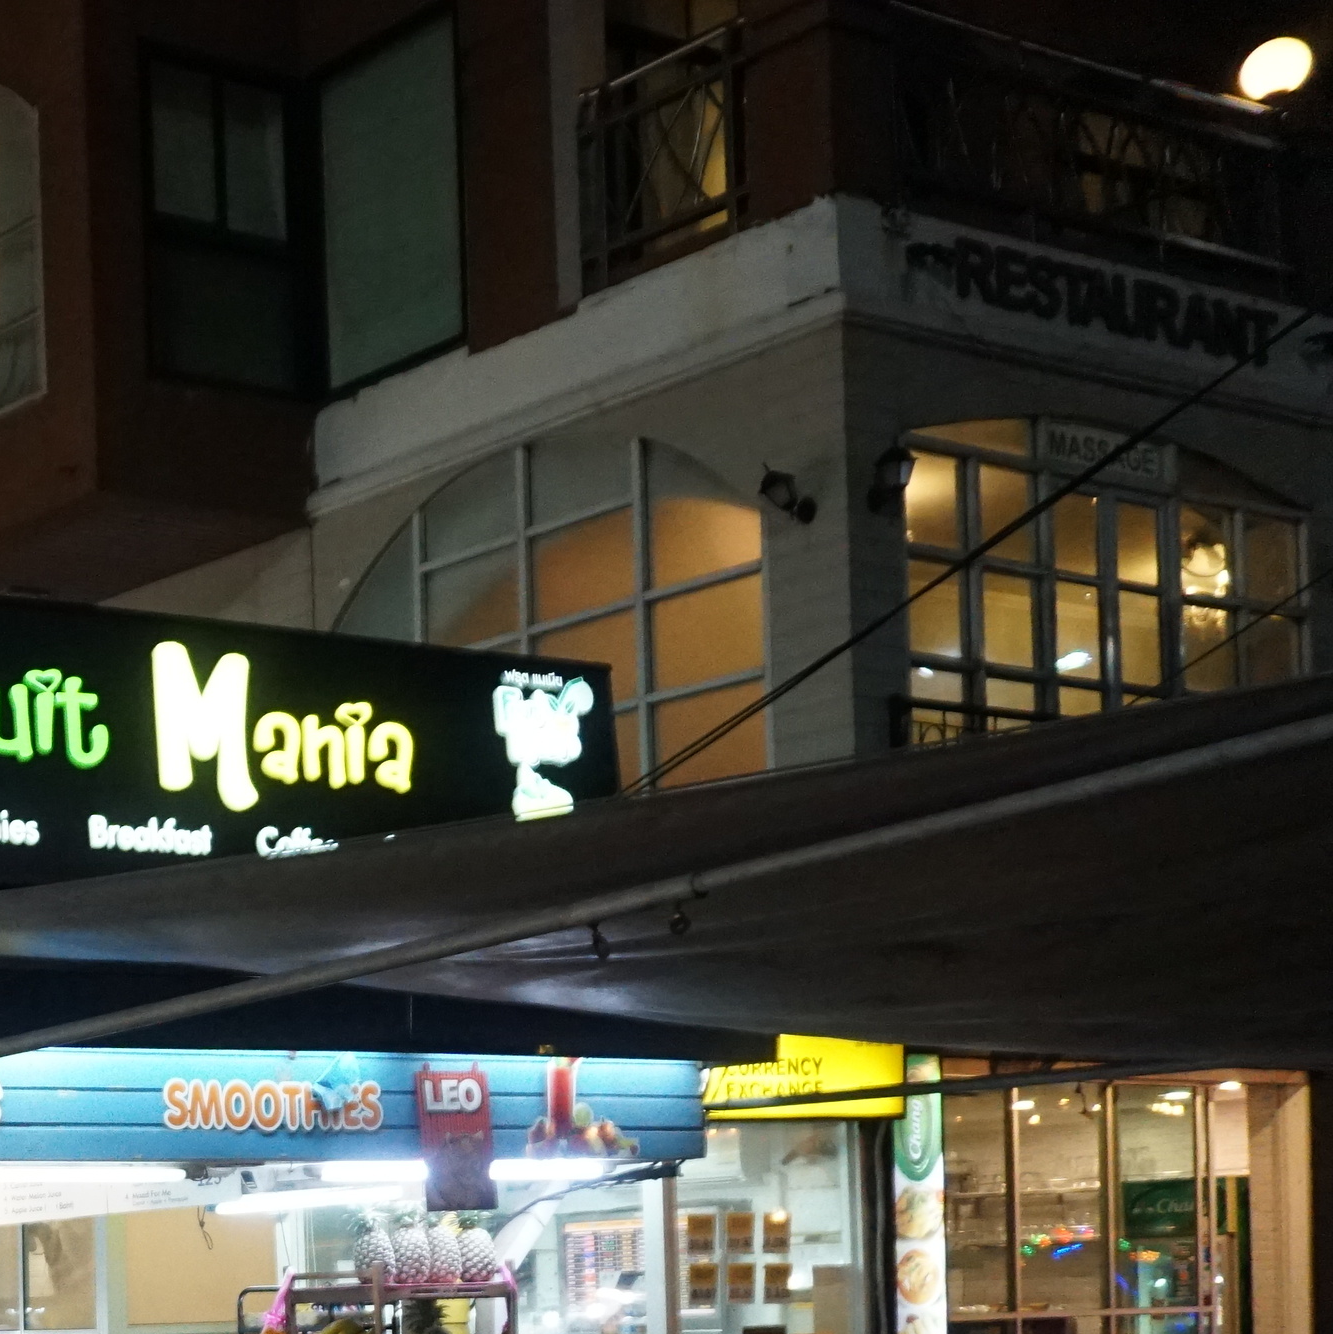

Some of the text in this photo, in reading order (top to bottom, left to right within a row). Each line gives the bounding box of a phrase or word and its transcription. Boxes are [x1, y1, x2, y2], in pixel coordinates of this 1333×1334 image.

[955, 236, 1278, 368] RESTAURANT
[1047, 429, 1159, 476] MASSAGE
[151, 640, 414, 811] Mania
[87, 813, 213, 857] Breakfast
[423, 1078, 483, 1112] LEO
[908, 1099, 923, 1160] Chang
